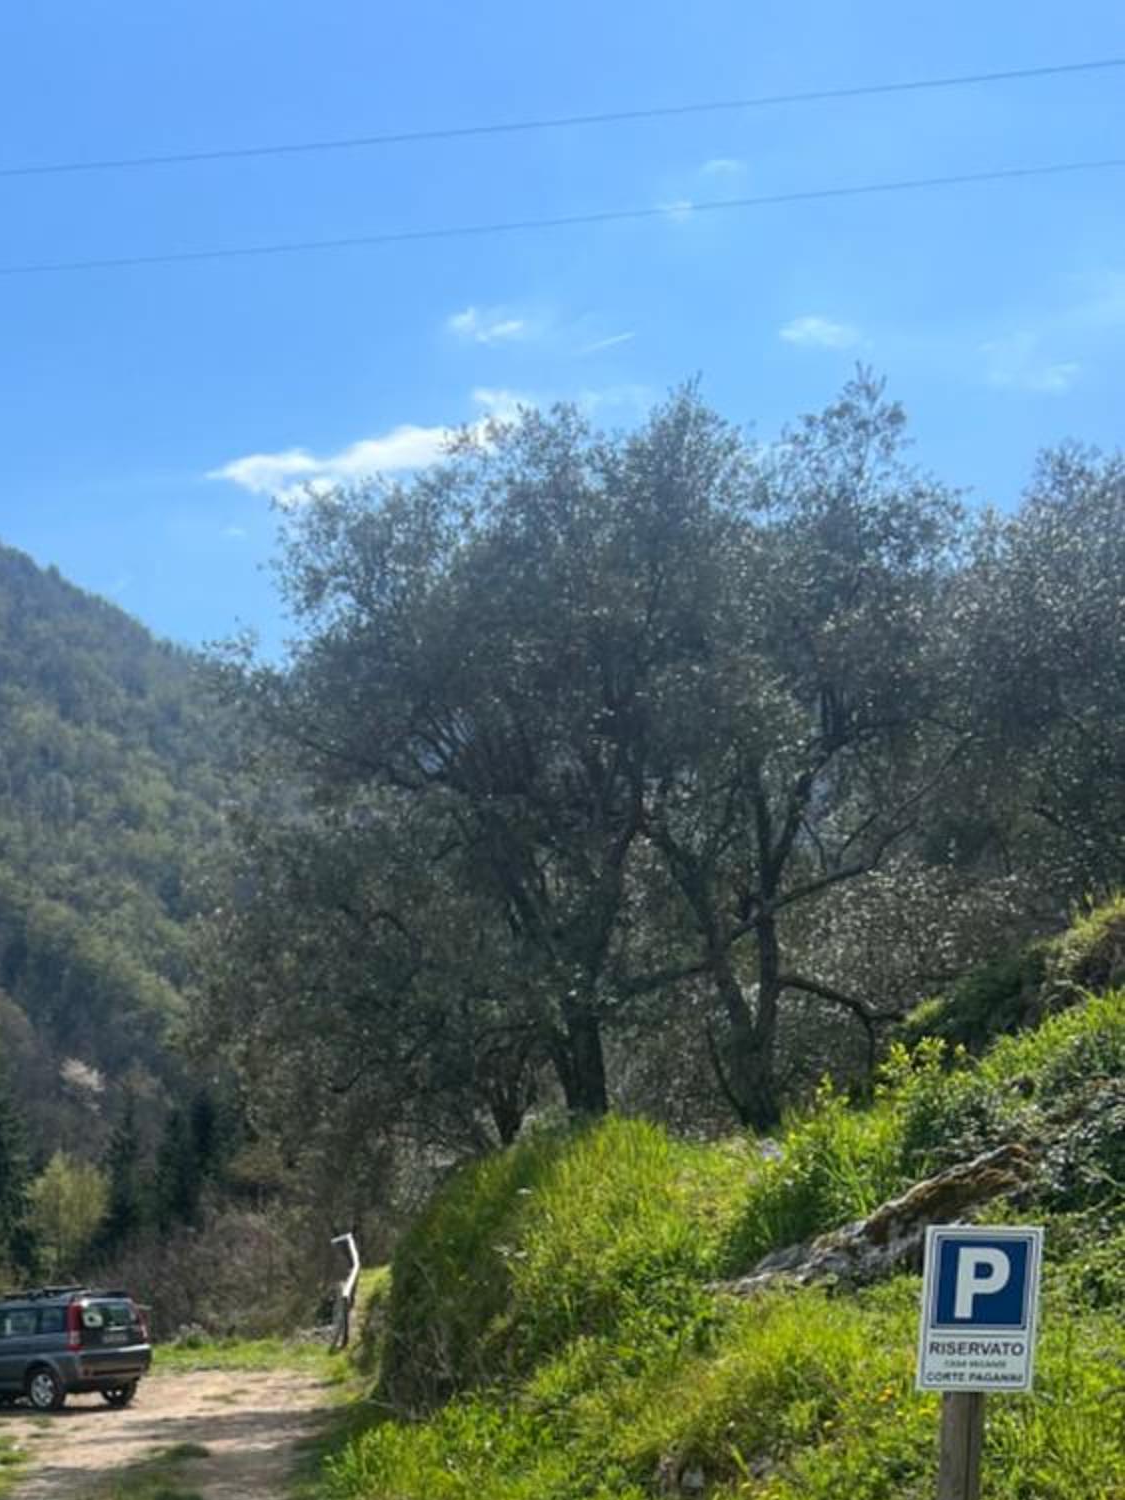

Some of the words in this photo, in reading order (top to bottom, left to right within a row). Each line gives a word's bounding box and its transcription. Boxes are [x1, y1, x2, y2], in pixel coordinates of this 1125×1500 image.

[954, 1247, 1010, 1319] P
[929, 1341, 1024, 1356] RISERVATO
[926, 1371, 964, 1382] CORTE
